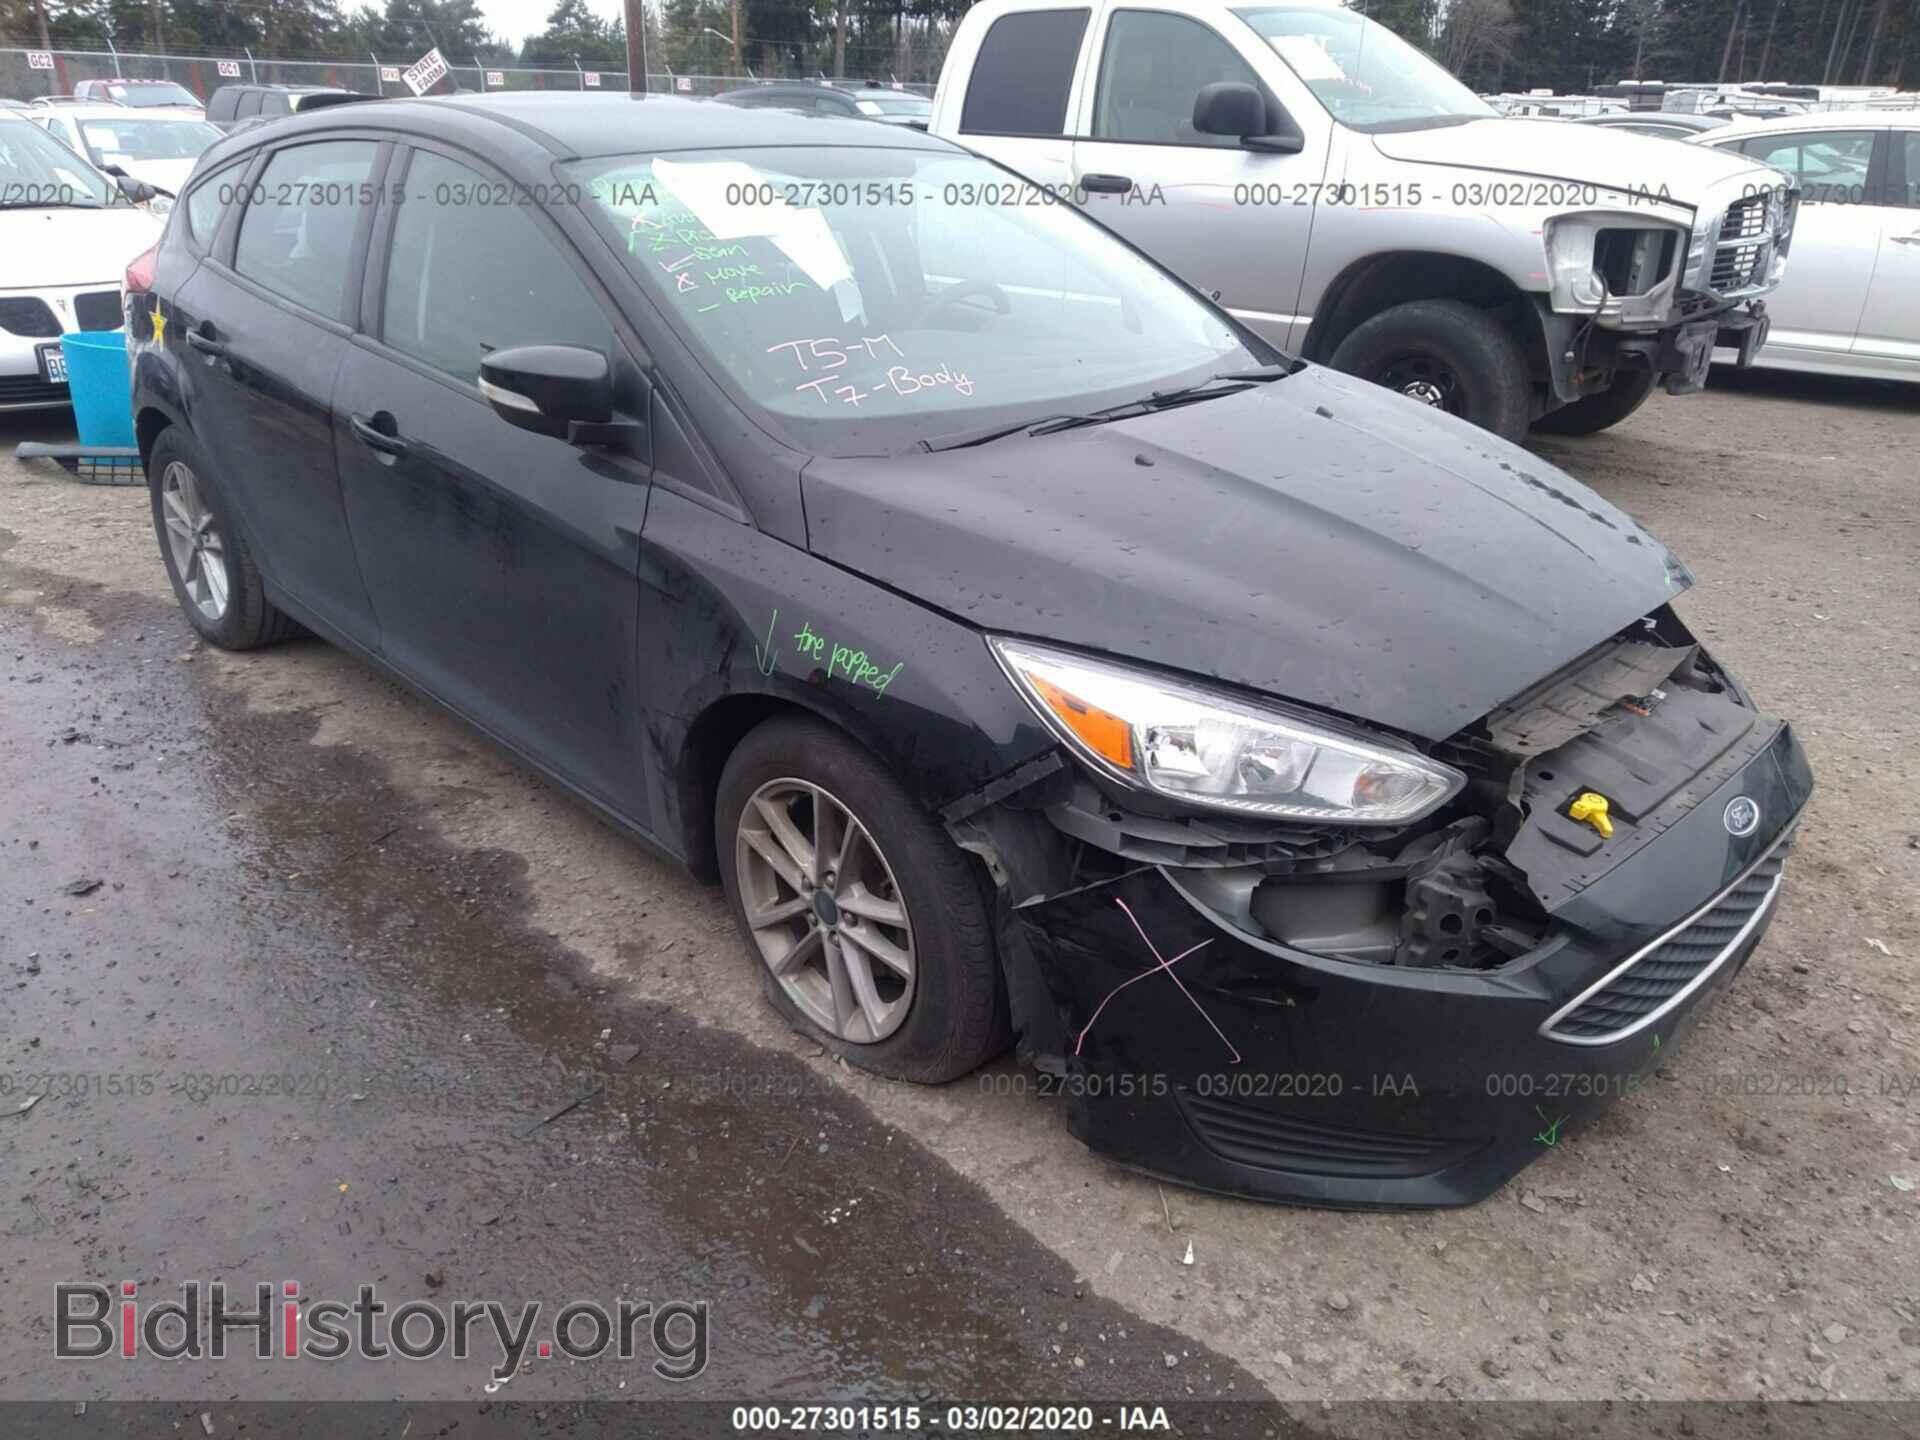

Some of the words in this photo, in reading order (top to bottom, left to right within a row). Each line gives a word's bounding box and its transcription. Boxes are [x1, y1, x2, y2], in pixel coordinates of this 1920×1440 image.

[31, 54, 53, 68] GC2
[408, 52, 439, 81] STATE
[416, 64, 446, 91] FARM
[725, 281, 811, 304] Repair
[794, 622, 825, 660] tire
[827, 643, 905, 700] popped
